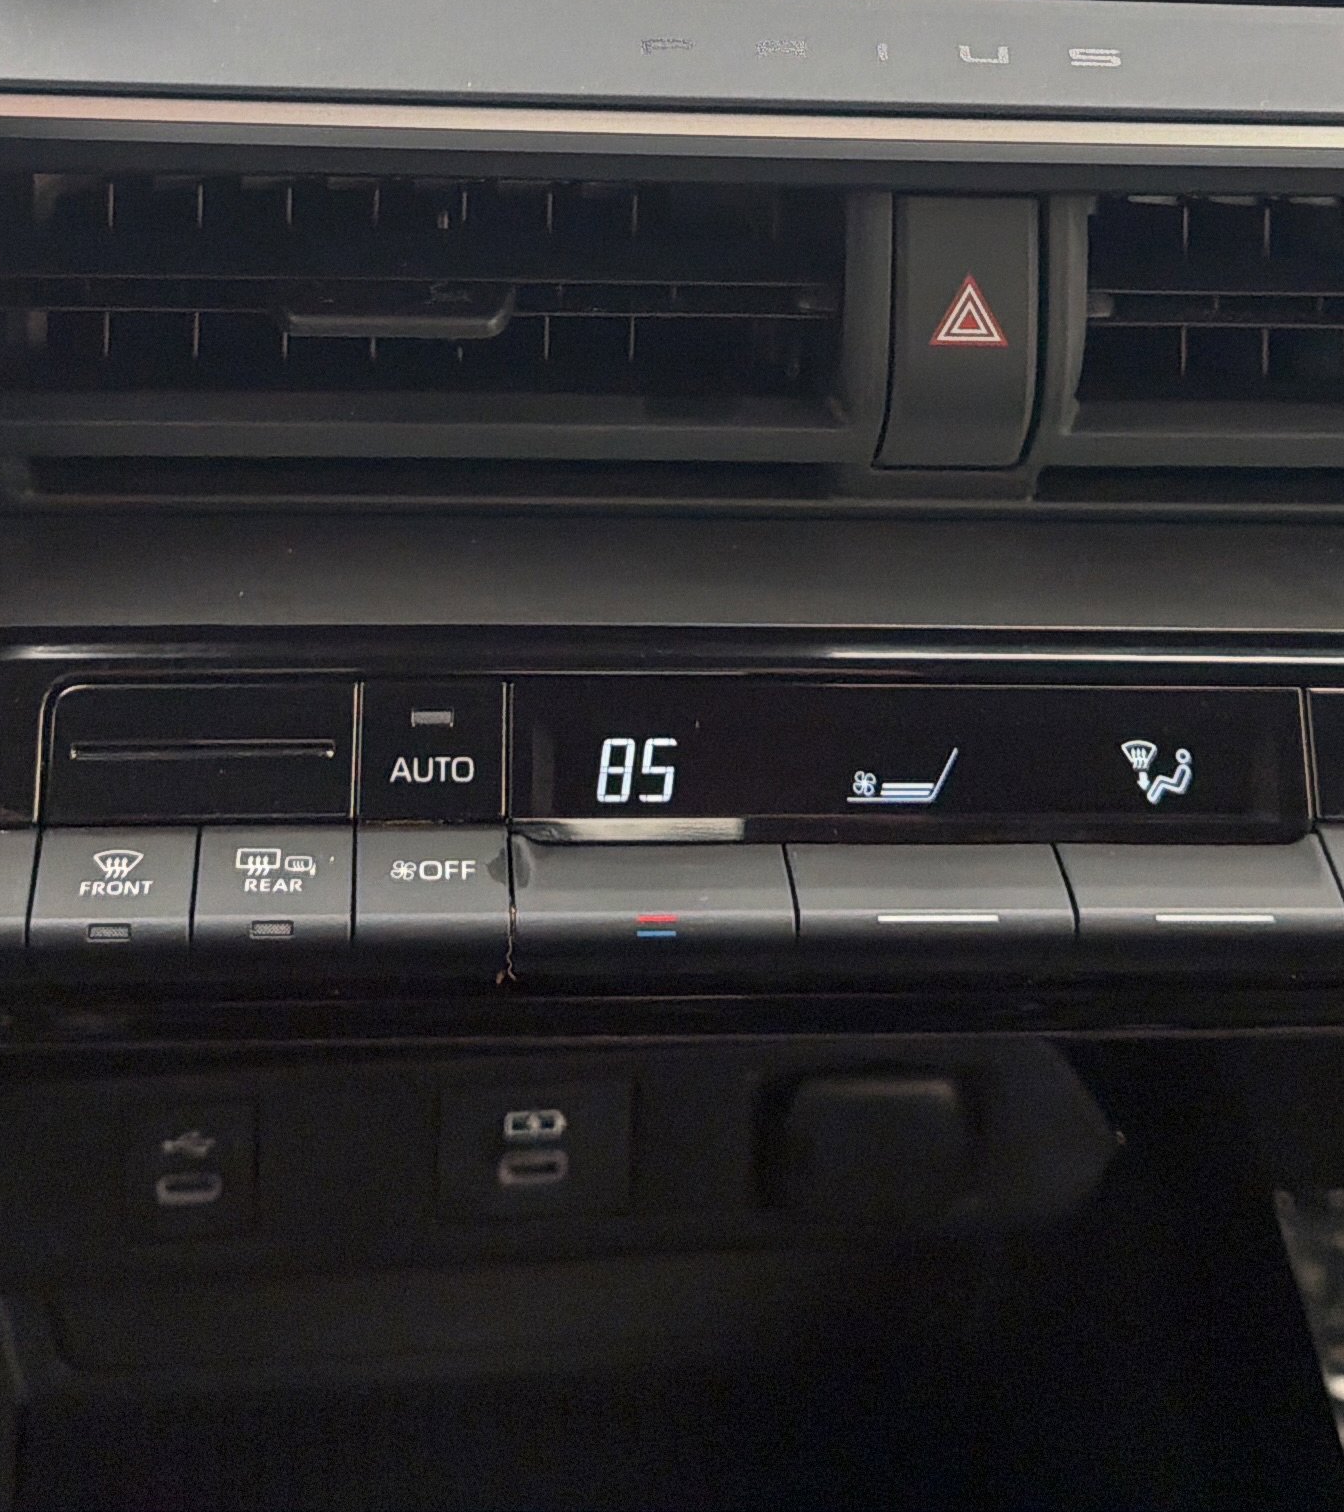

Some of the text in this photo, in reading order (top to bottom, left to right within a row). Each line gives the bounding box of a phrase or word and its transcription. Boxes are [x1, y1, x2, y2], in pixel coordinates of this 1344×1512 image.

[389, 756, 476, 783] AUTO
[596, 738, 678, 803] 85
[418, 859, 477, 881] OFF
[78, 880, 154, 896] FRONT
[244, 878, 304, 893] REAR
